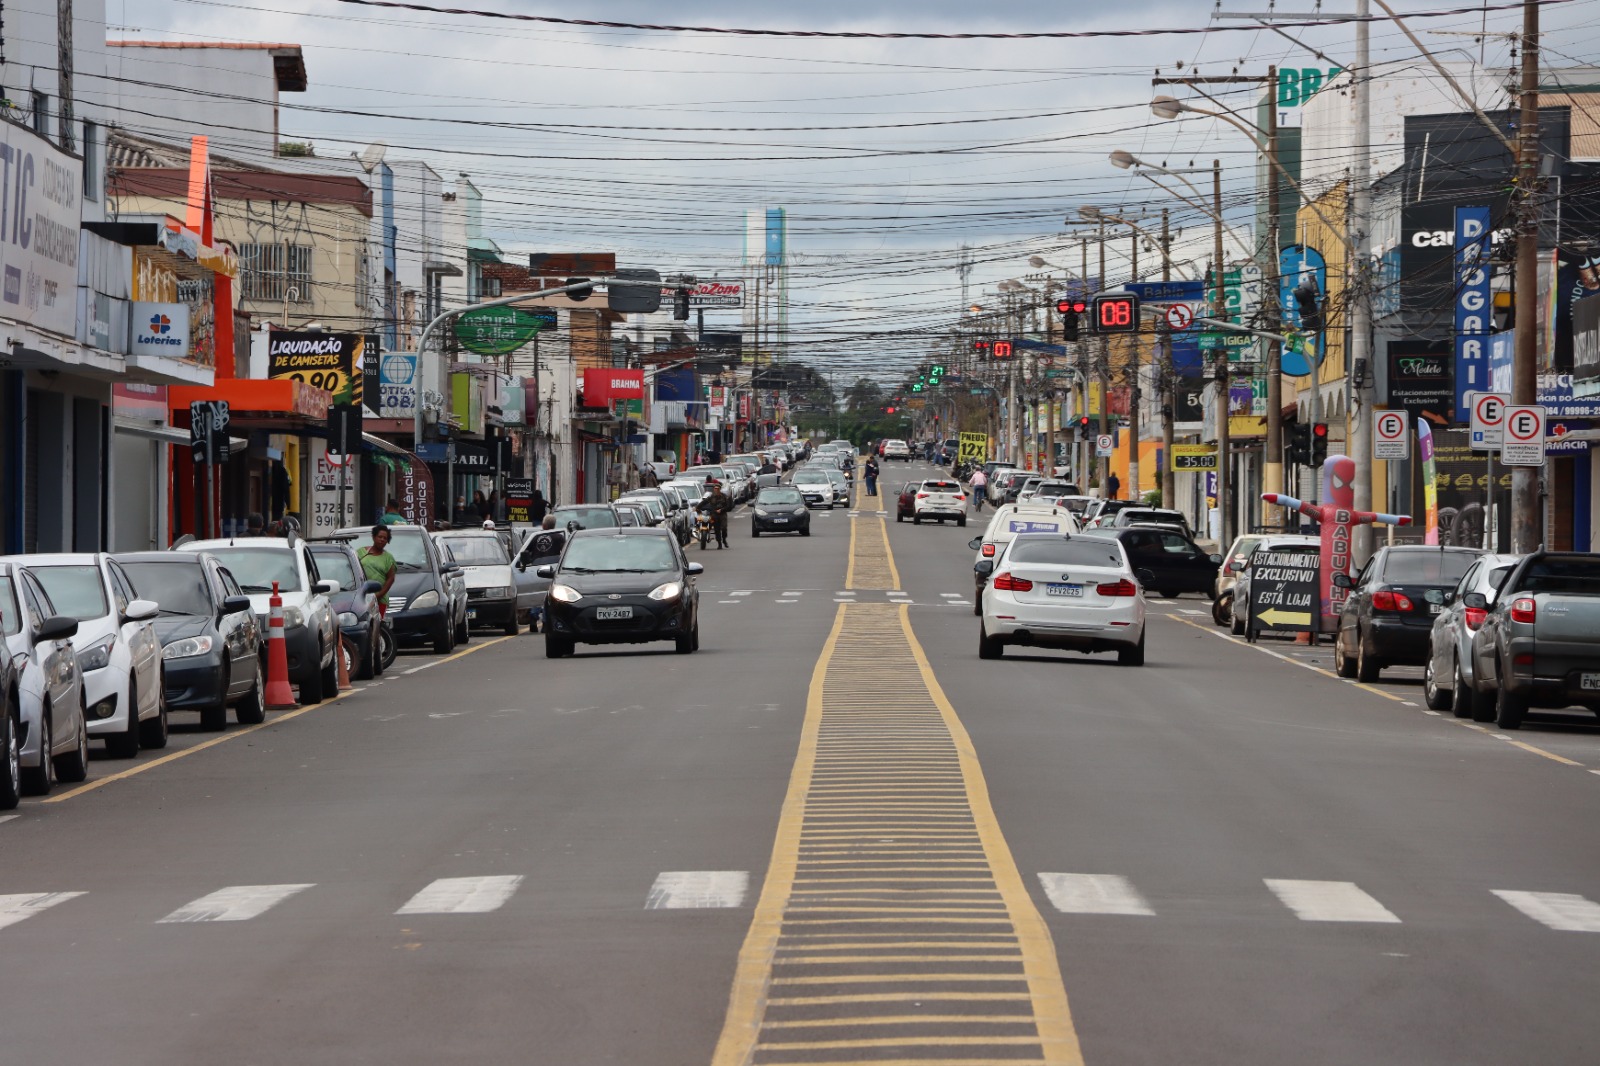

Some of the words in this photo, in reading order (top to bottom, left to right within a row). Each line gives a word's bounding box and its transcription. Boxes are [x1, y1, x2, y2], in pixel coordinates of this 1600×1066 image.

[465, 312, 516, 326] natural
[1101, 302, 1131, 326] 08
[137, 334, 182, 346] Loterias
[270, 337, 342, 355] LIQUIDAÇÃO
[1222, 335, 1251, 346] 1GIGA
[994, 342, 1011, 357] 07
[275, 356, 288, 366] DE
[289, 354, 340, 366] CAMISETAS
[1403, 362, 1442, 377] Modelo
[611, 379, 640, 389] BRAHMA
[1486, 402, 1497, 419] E
[1386, 419, 1396, 433] E
[1518, 416, 1531, 433] E
[961, 433, 985, 442] PNEUS
[1101, 438, 1108, 446] E
[1184, 456, 1215, 467] 35.00
[1253, 552, 1320, 569] ESTACIONAMENTO
[1254, 568, 1314, 582] EXCLUSIVO
[1258, 591, 1284, 605] ESTÁ
[1286, 593, 1311, 606] LOJA
